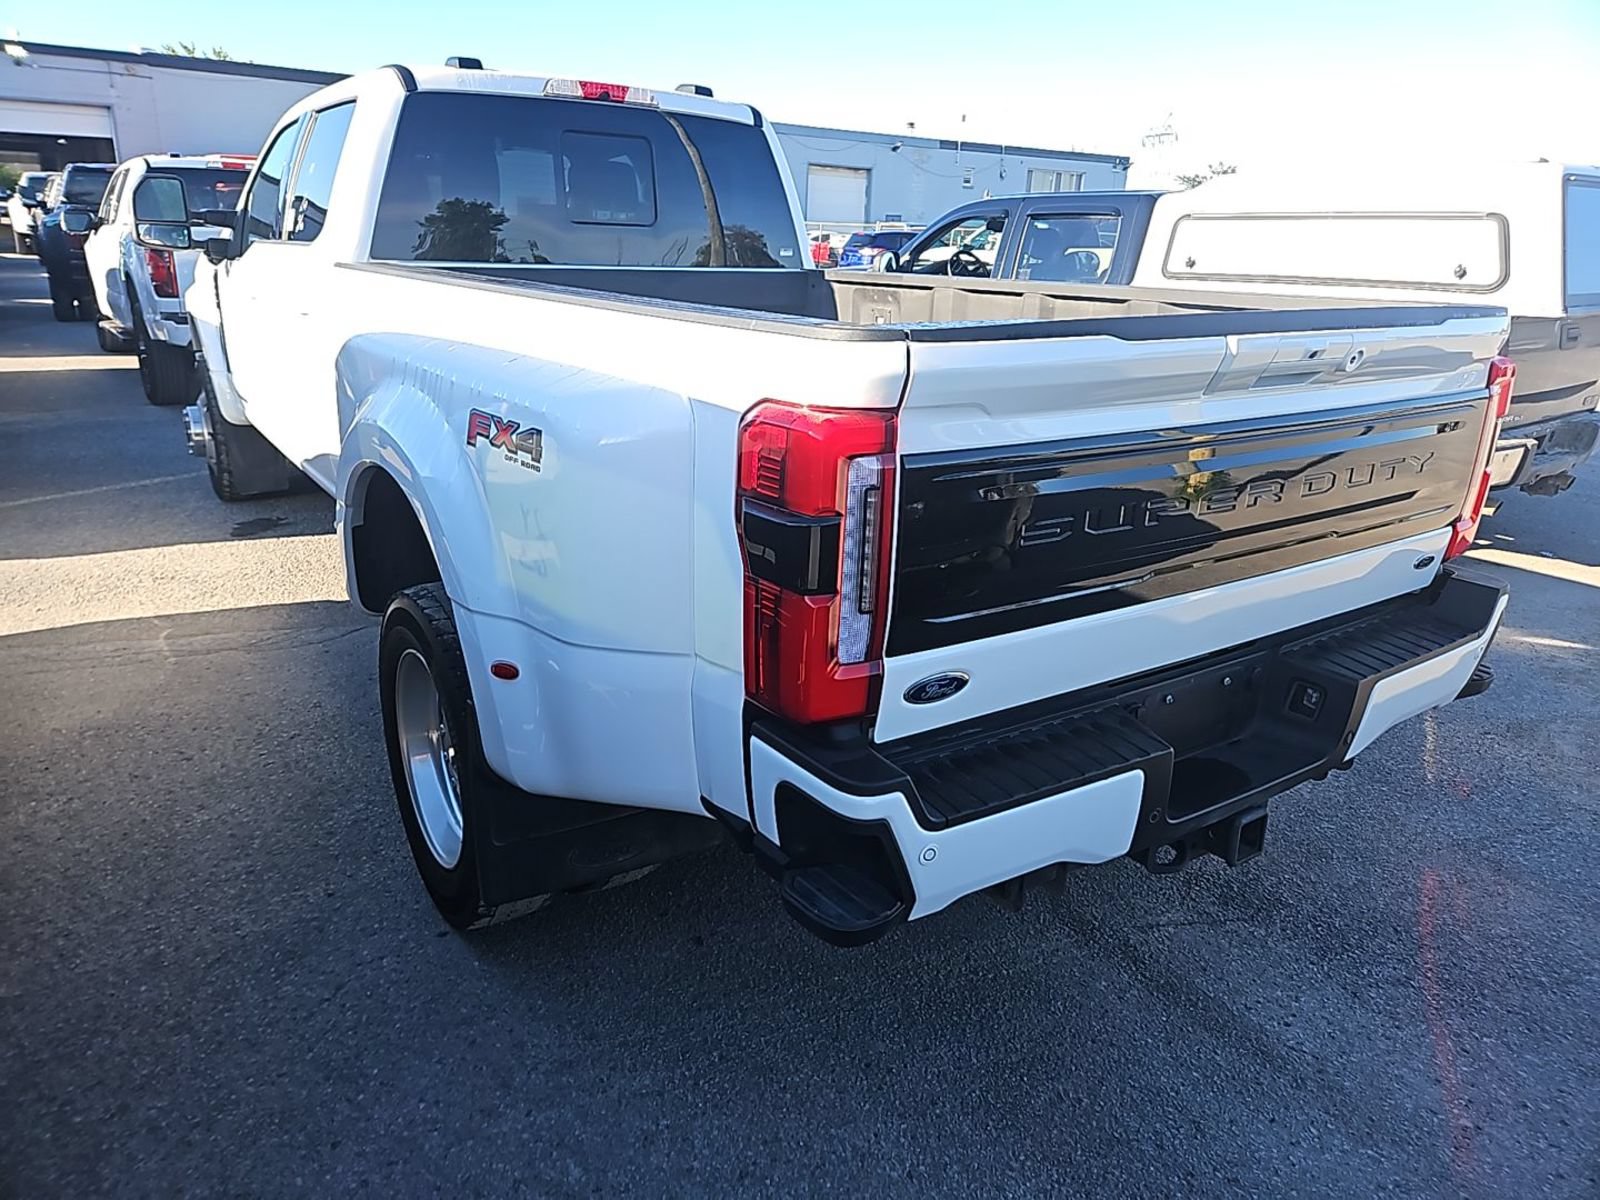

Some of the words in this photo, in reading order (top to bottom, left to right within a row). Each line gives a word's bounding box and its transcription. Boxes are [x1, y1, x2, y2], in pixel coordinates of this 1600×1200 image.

[466, 408, 542, 464] FX4
[504, 454, 519, 464] OFF
[520, 460, 541, 473] ROAD
[1019, 478, 1286, 546] SUPER
[1300, 451, 1435, 498] DUTY
[921, 679, 958, 699] Ford
